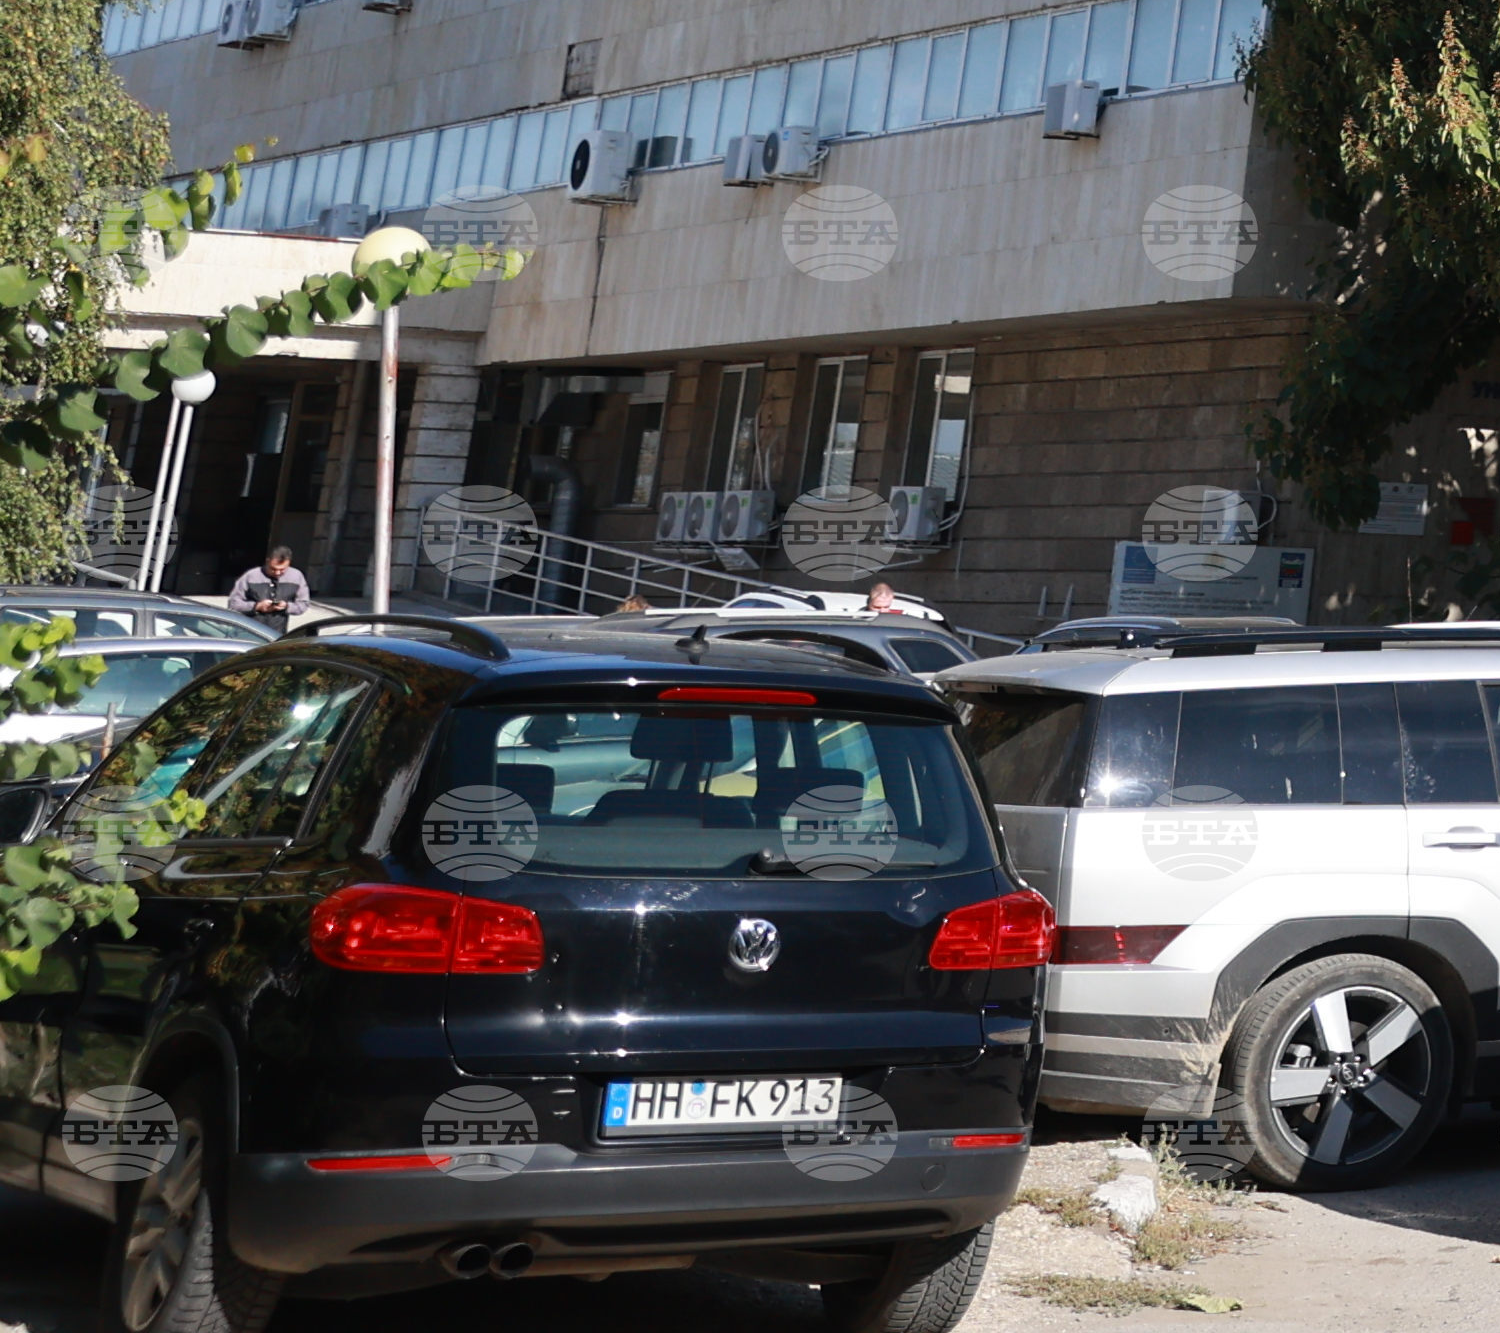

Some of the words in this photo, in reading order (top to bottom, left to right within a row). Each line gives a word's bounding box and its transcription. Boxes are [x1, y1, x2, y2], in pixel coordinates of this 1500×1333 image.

[611, 1106, 624, 1118] D
[632, 1081, 684, 1120] HH
[710, 1080, 757, 1118] FK
[770, 1077, 836, 1116] 913
